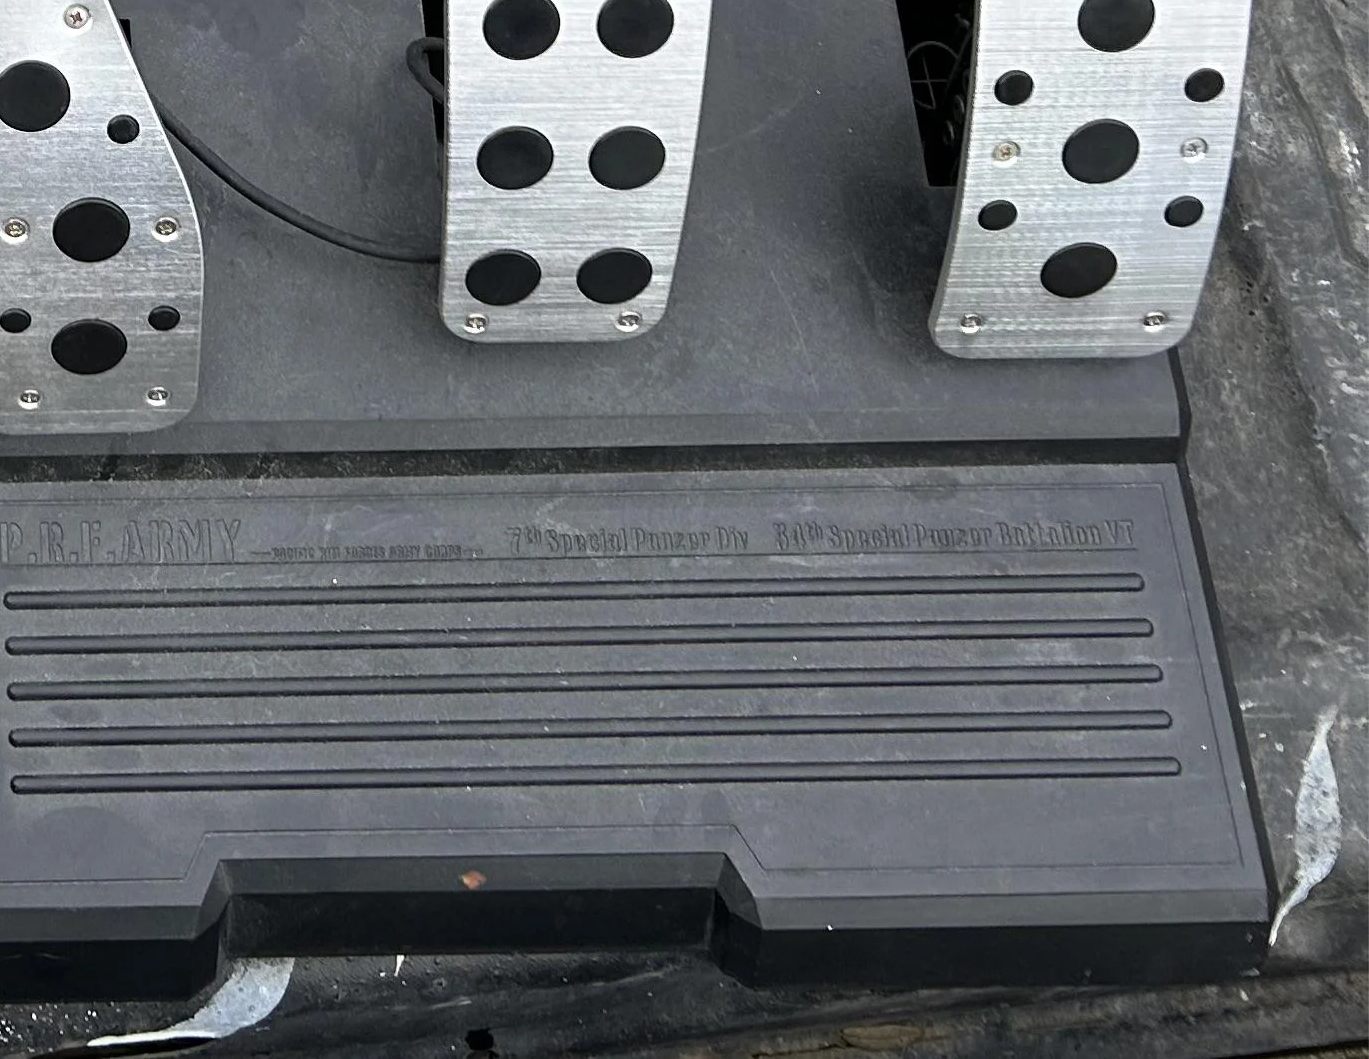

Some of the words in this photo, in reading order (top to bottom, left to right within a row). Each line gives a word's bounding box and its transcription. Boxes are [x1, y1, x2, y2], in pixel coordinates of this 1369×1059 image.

[544, 527, 628, 555] Special
[715, 525, 750, 552] Div
[826, 521, 911, 553] Special
[996, 520, 1102, 547] Battalion
[1104, 518, 1135, 545] VT
